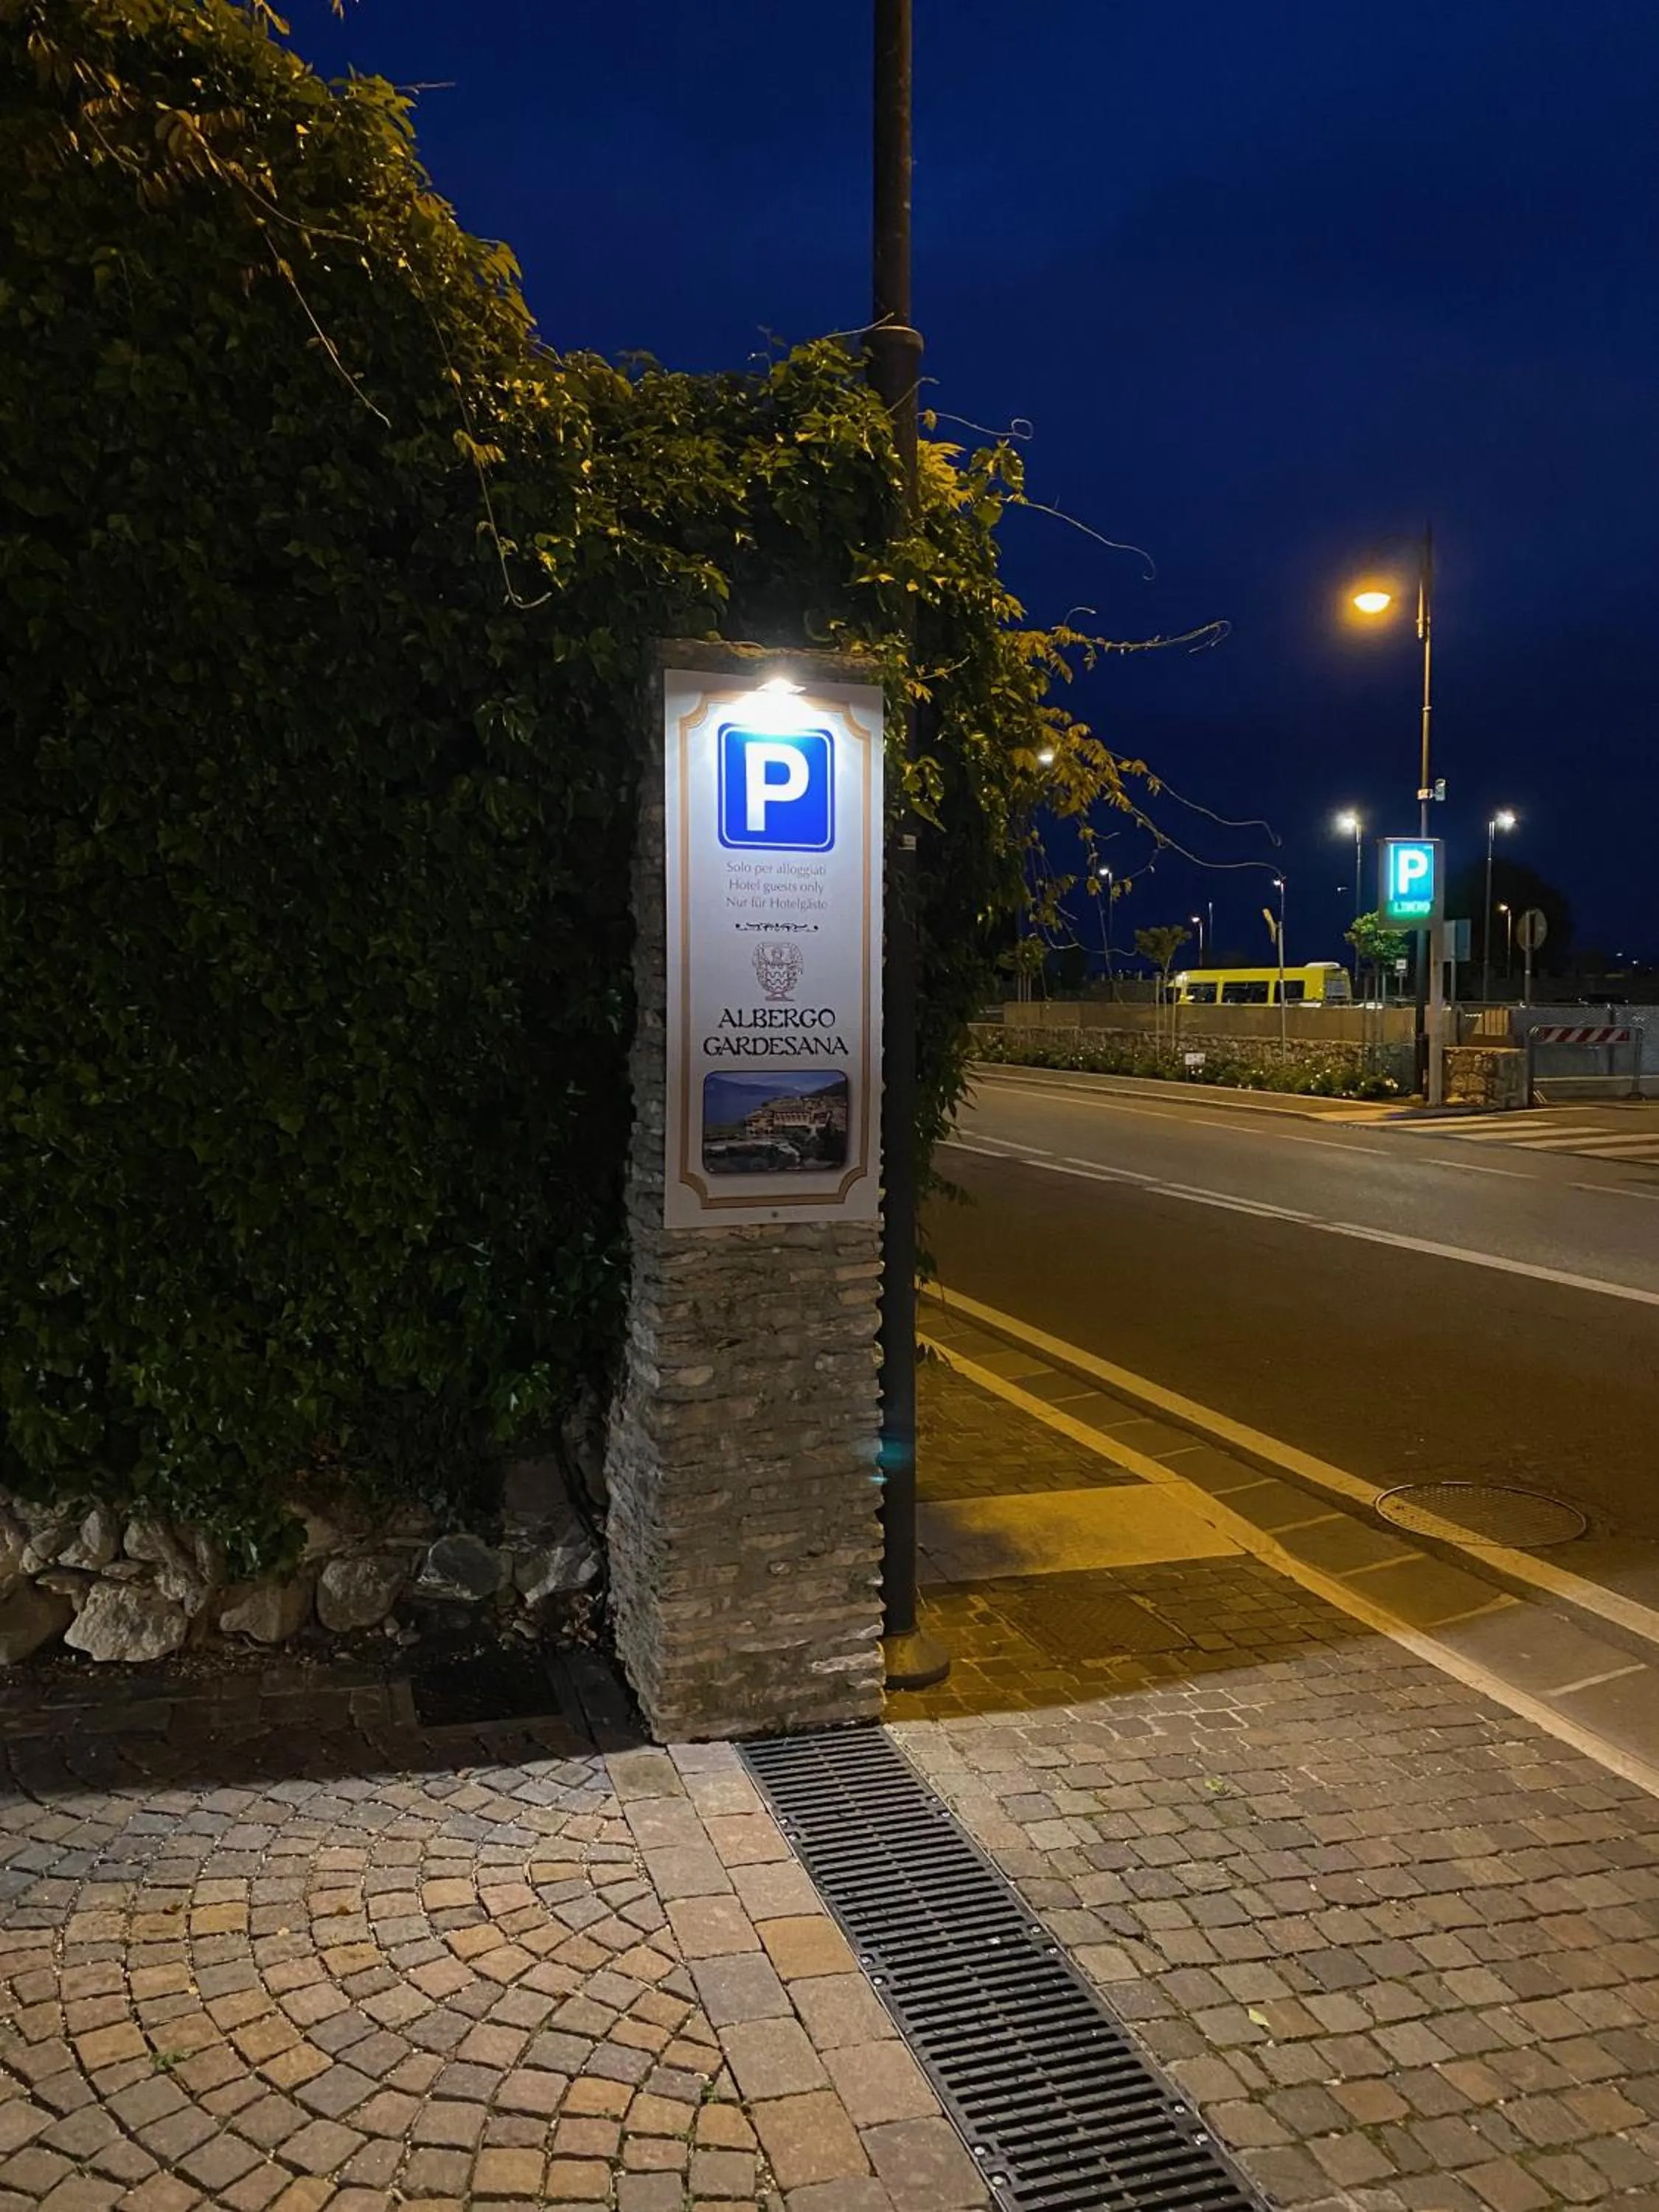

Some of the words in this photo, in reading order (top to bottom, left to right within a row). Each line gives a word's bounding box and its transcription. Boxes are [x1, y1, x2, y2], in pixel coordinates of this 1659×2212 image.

[745, 742, 810, 831] P
[726, 861, 751, 873] Solo
[754, 864, 772, 876] per
[776, 863, 826, 878] alloggiati
[1398, 849, 1427, 894] P
[729, 878, 760, 891] Hotel
[764, 880, 797, 894] guests
[800, 880, 824, 895] only
[726, 897, 748, 908] Nur
[751, 896, 766, 908] für
[717, 1008, 835, 1029] ALBERGO
[703, 1036, 849, 1056] GARDESANA
